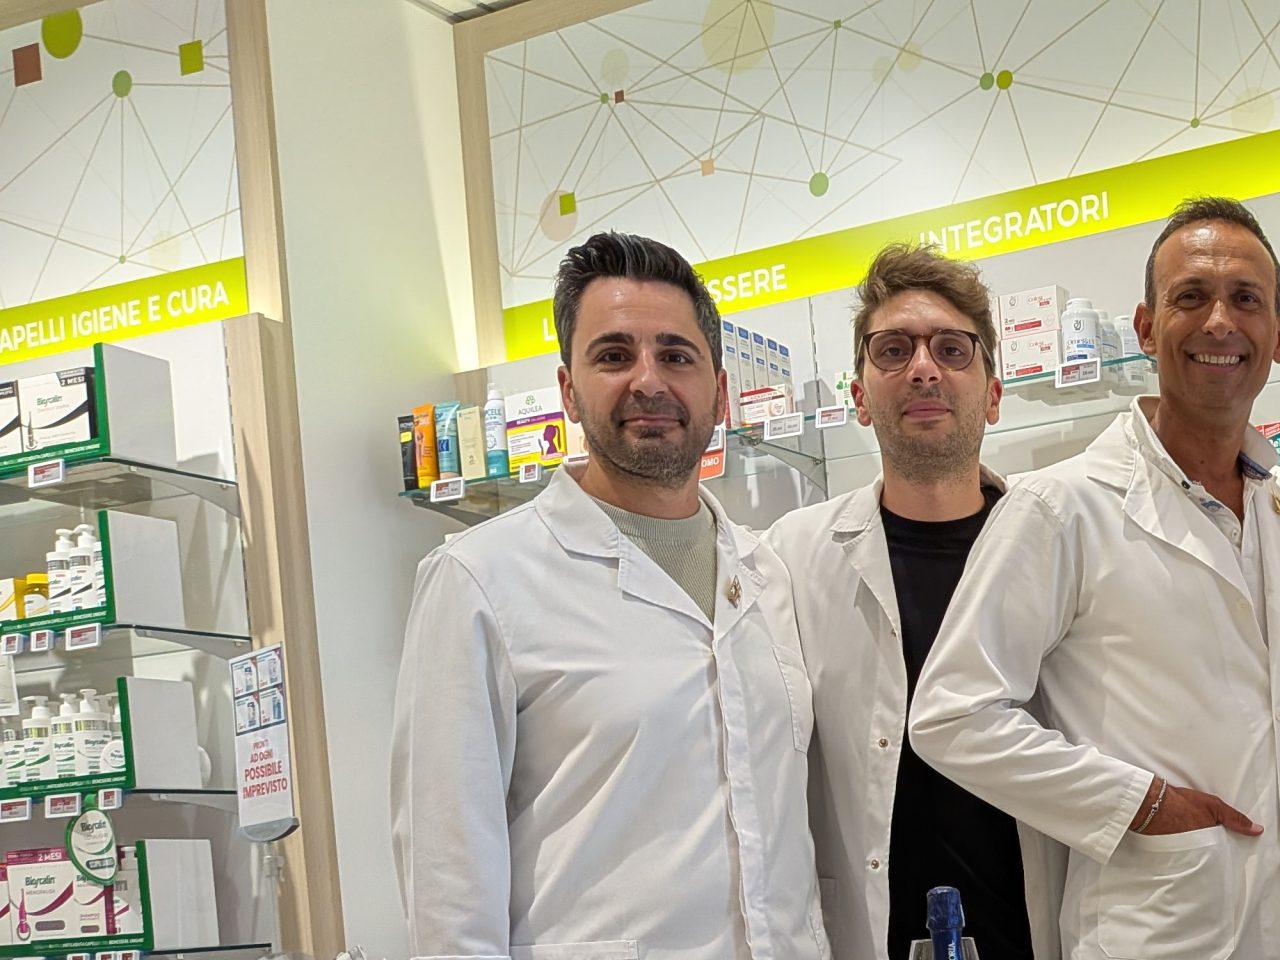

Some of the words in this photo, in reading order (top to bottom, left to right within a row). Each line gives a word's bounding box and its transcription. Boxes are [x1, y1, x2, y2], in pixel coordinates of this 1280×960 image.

[709, 264, 788, 303] SSERE
[0, 316, 65, 353] APELLI
[72, 306, 141, 338] IGIENE
[149, 295, 161, 321] E
[167, 281, 230, 320] CURA
[518, 405, 543, 415] AQUILEA
[701, 457, 720, 467] OMO
[244, 760, 283, 782] POSSIBILE
[243, 777, 288, 800] IMPREVISTO
